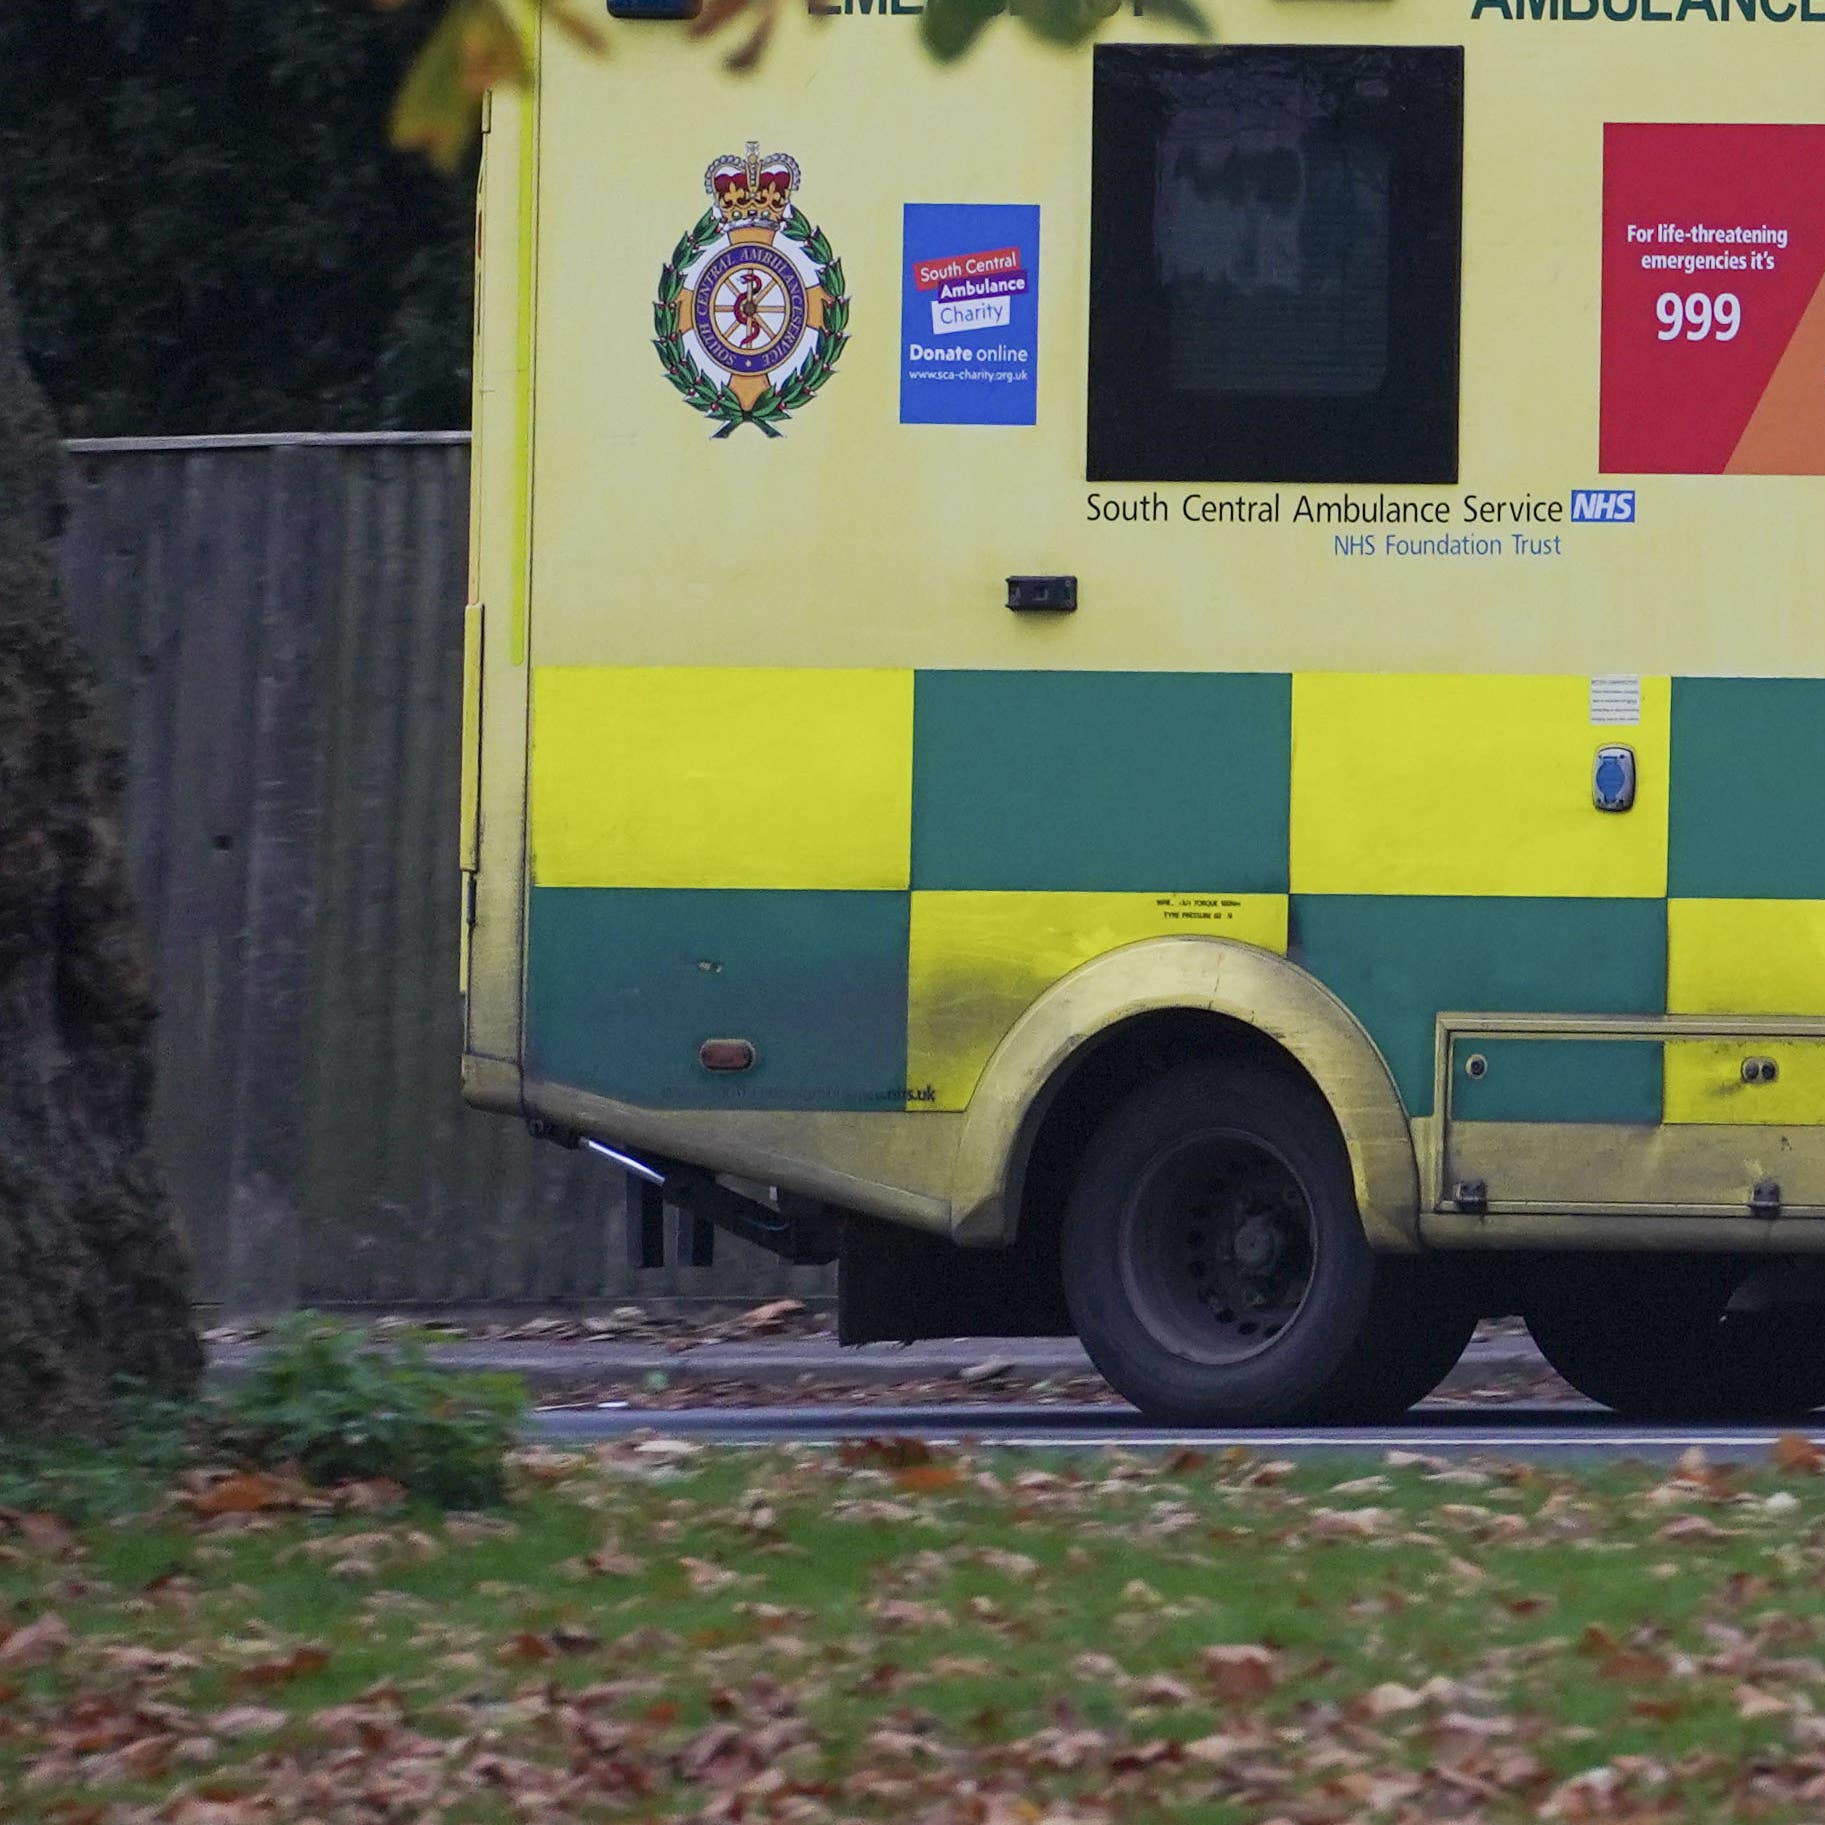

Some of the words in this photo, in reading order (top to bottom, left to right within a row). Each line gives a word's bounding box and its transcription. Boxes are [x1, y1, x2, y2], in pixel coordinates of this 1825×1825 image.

[1627, 224, 1654, 243] For
[1657, 223, 1788, 248] life-threatening
[920, 261, 962, 283] South
[965, 251, 1017, 274] Central
[1641, 250, 1748, 274] emergencies
[1750, 250, 1775, 270] it's
[940, 277, 1026, 299] Ambulance
[940, 302, 1003, 324] Charity
[1656, 292, 1741, 341] 999
[909, 343, 973, 361] Donate
[976, 344, 1028, 362] online
[1087, 492, 1168, 522] South
[1182, 493, 1280, 522] Central
[1292, 493, 1451, 523] Ambulance
[1463, 493, 1563, 523] Service
[1572, 491, 1634, 520] NHS
[1334, 534, 1376, 556] NHS
[1385, 533, 1502, 556] Foundation
[1511, 534, 1562, 556] Trust
